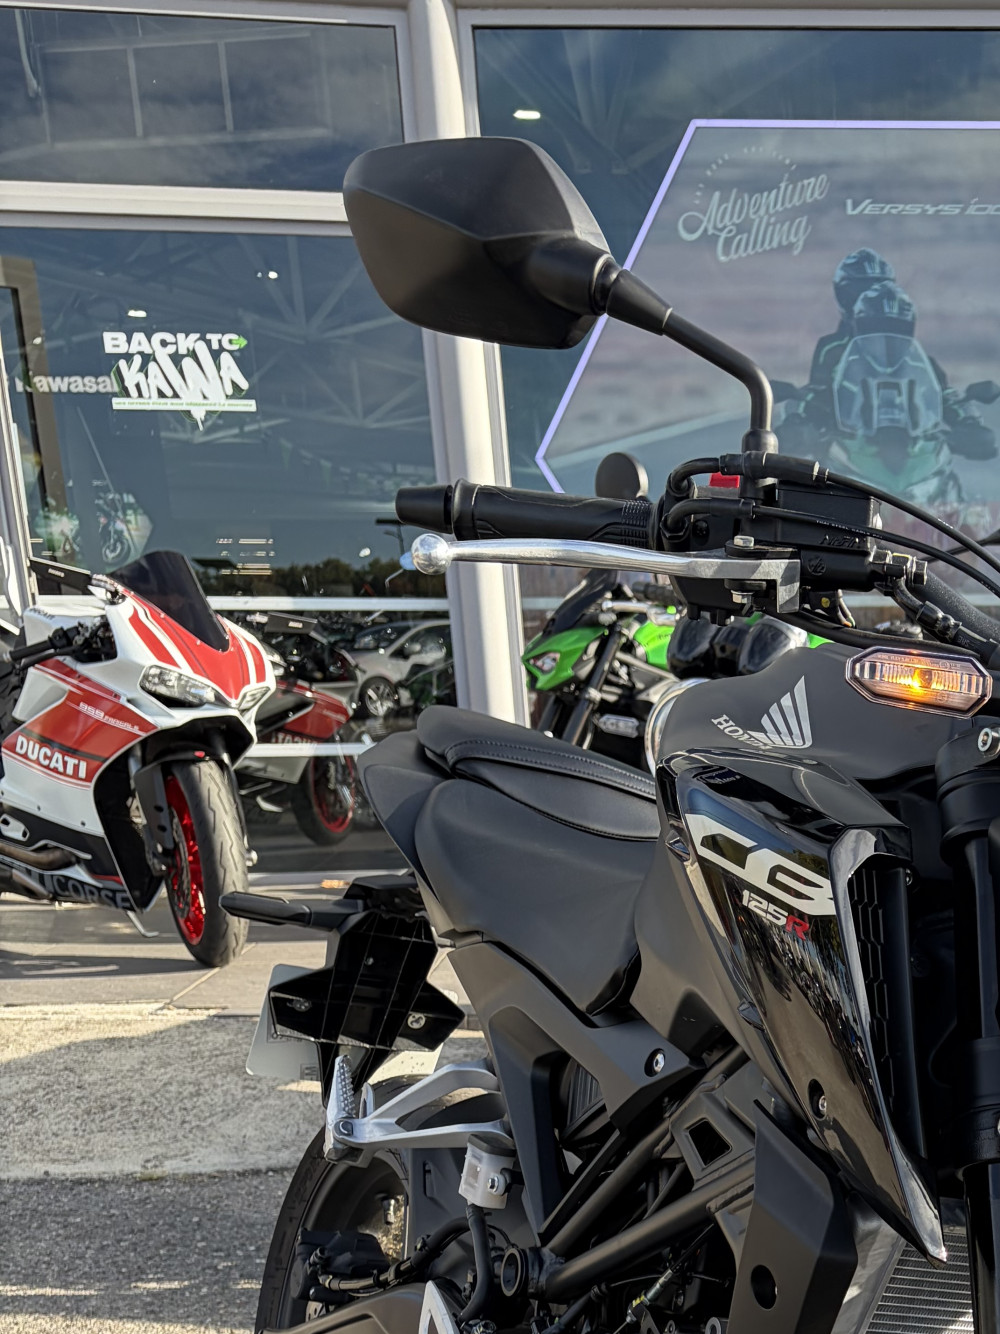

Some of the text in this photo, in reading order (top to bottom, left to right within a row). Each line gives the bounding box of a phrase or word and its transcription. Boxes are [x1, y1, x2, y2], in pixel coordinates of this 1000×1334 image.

[677, 174, 829, 241] Adventure
[715, 214, 811, 263] Calling
[103, 332, 242, 354] BACK TO
[711, 714, 773, 750] HONDA
[15, 734, 87, 779] DUCATI
[685, 813, 836, 916] CB
[52, 874, 131, 909] CORSE
